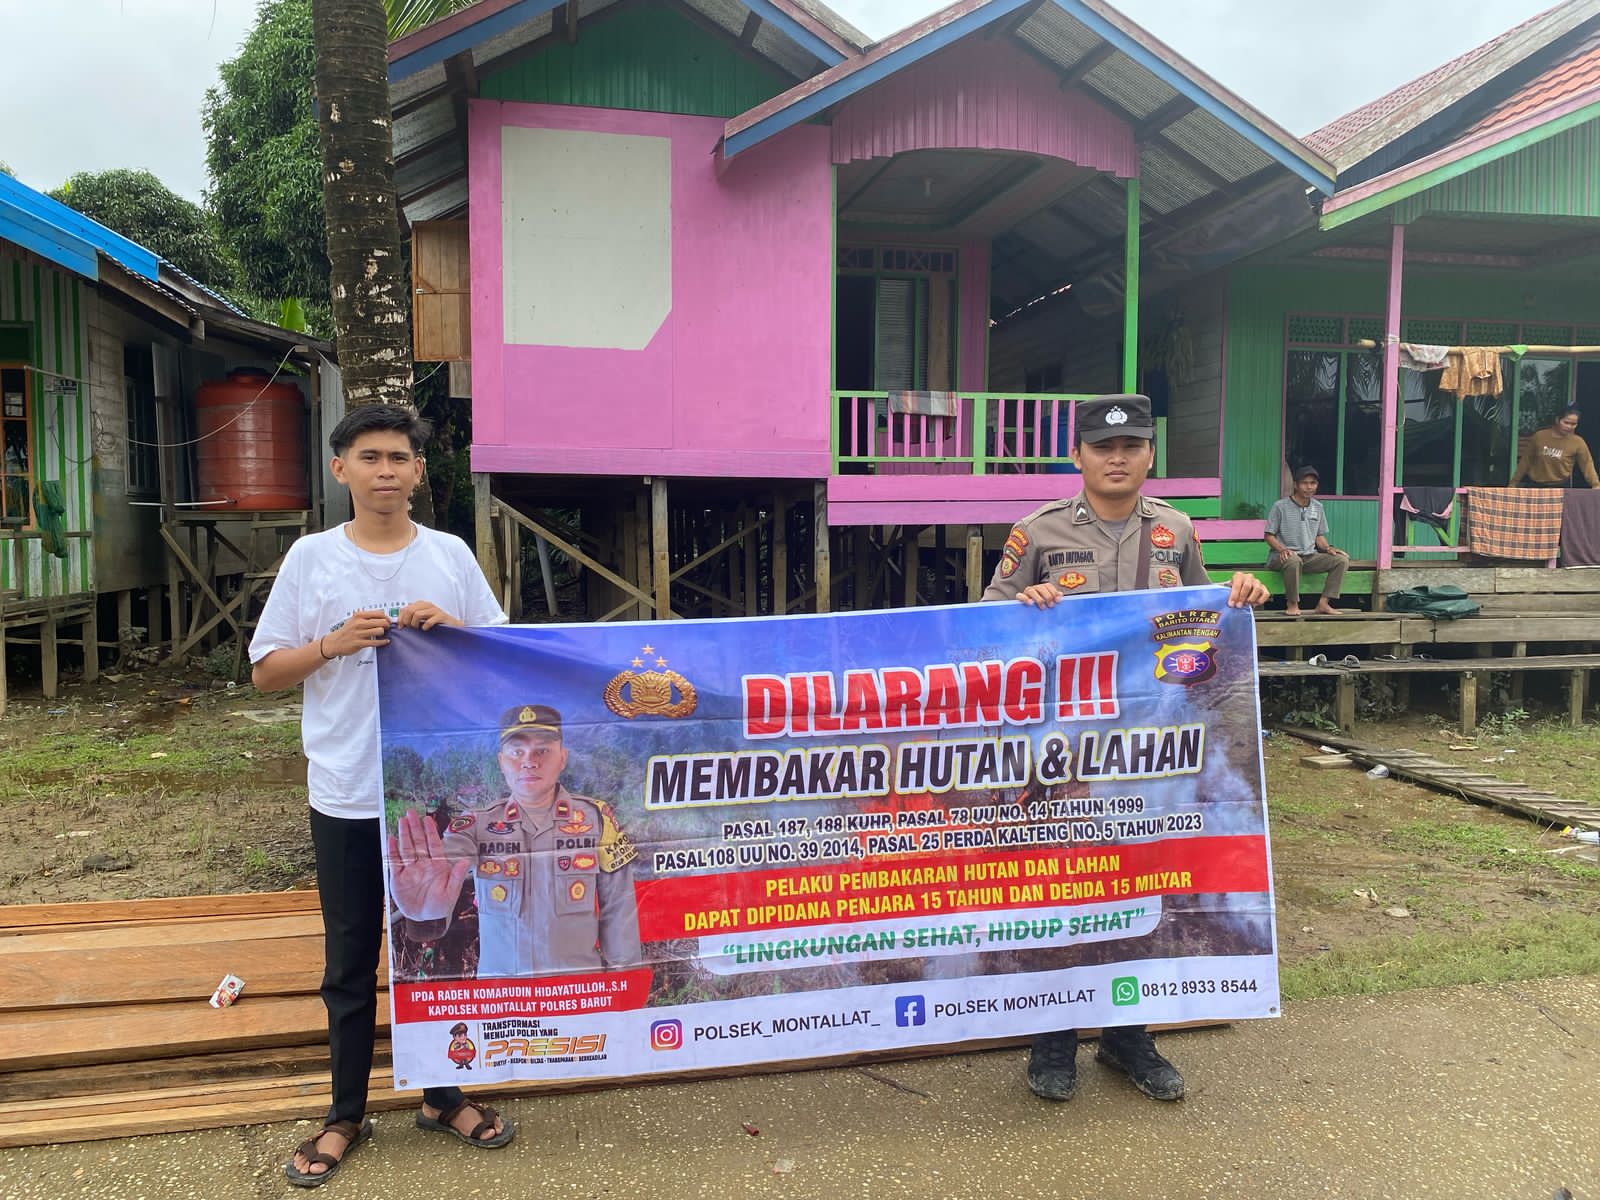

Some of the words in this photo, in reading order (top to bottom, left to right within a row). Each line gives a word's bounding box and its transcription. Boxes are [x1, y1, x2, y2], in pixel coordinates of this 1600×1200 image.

[1155, 611, 1218, 623] POLRES
[1158, 617, 1188, 628] BARITO
[744, 659, 1044, 737] DILARANG
[1057, 653, 1118, 720] !!!
[649, 749, 887, 804] MEMBAKAR
[899, 741, 1026, 788] HUTAN
[1040, 737, 1069, 780] &
[1080, 728, 1202, 777] LAHAN
[723, 821, 773, 840] PASAL
[778, 819, 811, 838] 187,
[815, 817, 842, 832] 188
[846, 814, 893, 832] KUHP,
[898, 811, 946, 827] PASAL
[951, 809, 968, 824] 78
[973, 807, 995, 823] UU
[999, 805, 1025, 821] NO.
[1029, 802, 1047, 818] 14
[1051, 799, 1104, 817] TAHUN
[1108, 797, 1144, 813] 1999
[479, 841, 521, 854] RADEN
[556, 837, 596, 850] POLRI
[740, 845, 763, 862] UU
[768, 843, 796, 861] NO.
[800, 841, 818, 858] 39
[823, 840, 864, 858] 2014,
[868, 835, 917, 852] PASAL
[921, 833, 940, 849] 25
[944, 831, 994, 848] PERDA
[998, 825, 1068, 846] KALTENG
[1072, 823, 1100, 840] NO.
[1104, 823, 1114, 838] 5
[1118, 818, 1165, 838] TAHUN
[1167, 814, 1202, 831] 2023
[765, 874, 833, 898] PELAKU
[839, 864, 958, 892] PEMBAKARAN
[964, 859, 1019, 881] HUTAN
[1025, 857, 1059, 877] DAN
[1065, 854, 1121, 875] LAHAN
[683, 908, 740, 932] DAPAT
[746, 901, 831, 926] DIPIDANA
[836, 894, 916, 918] PENJARA
[920, 892, 942, 910] 15
[947, 887, 1003, 907] TAHUN
[1009, 885, 1044, 903] DAN
[1049, 882, 1105, 902] DENDA
[1110, 879, 1130, 896] 15
[1135, 871, 1192, 893] MILYAR
[902, 923, 981, 948] SEHAT,
[988, 917, 1063, 943] HIDUP
[411, 991, 435, 1003] IPDA
[437, 989, 470, 1001] RADEN
[473, 986, 532, 1000] KOMARUDIN
[428, 1005, 478, 1017] KAPOLSEK
[480, 1001, 537, 1014] MONTALLAT
[540, 998, 578, 1012] POLRES
[580, 996, 613, 1008] BARUT
[693, 1009, 881, 1042] POLSEK_MONTALLAT_
[934, 999, 999, 1018] POLSEK
[1003, 988, 1097, 1012] MONTALLAT
[1141, 982, 1178, 997] 0812
[1181, 980, 1216, 994] 8933
[1221, 979, 1257, 993] 8544
[482, 1020, 540, 1031] TRANSFORMASI
[484, 1030, 516, 1040] MENUJU
[517, 1029, 538, 1038] POLRI
[539, 1028, 558, 1037] YANG
[485, 1034, 607, 1060] PRESISI
